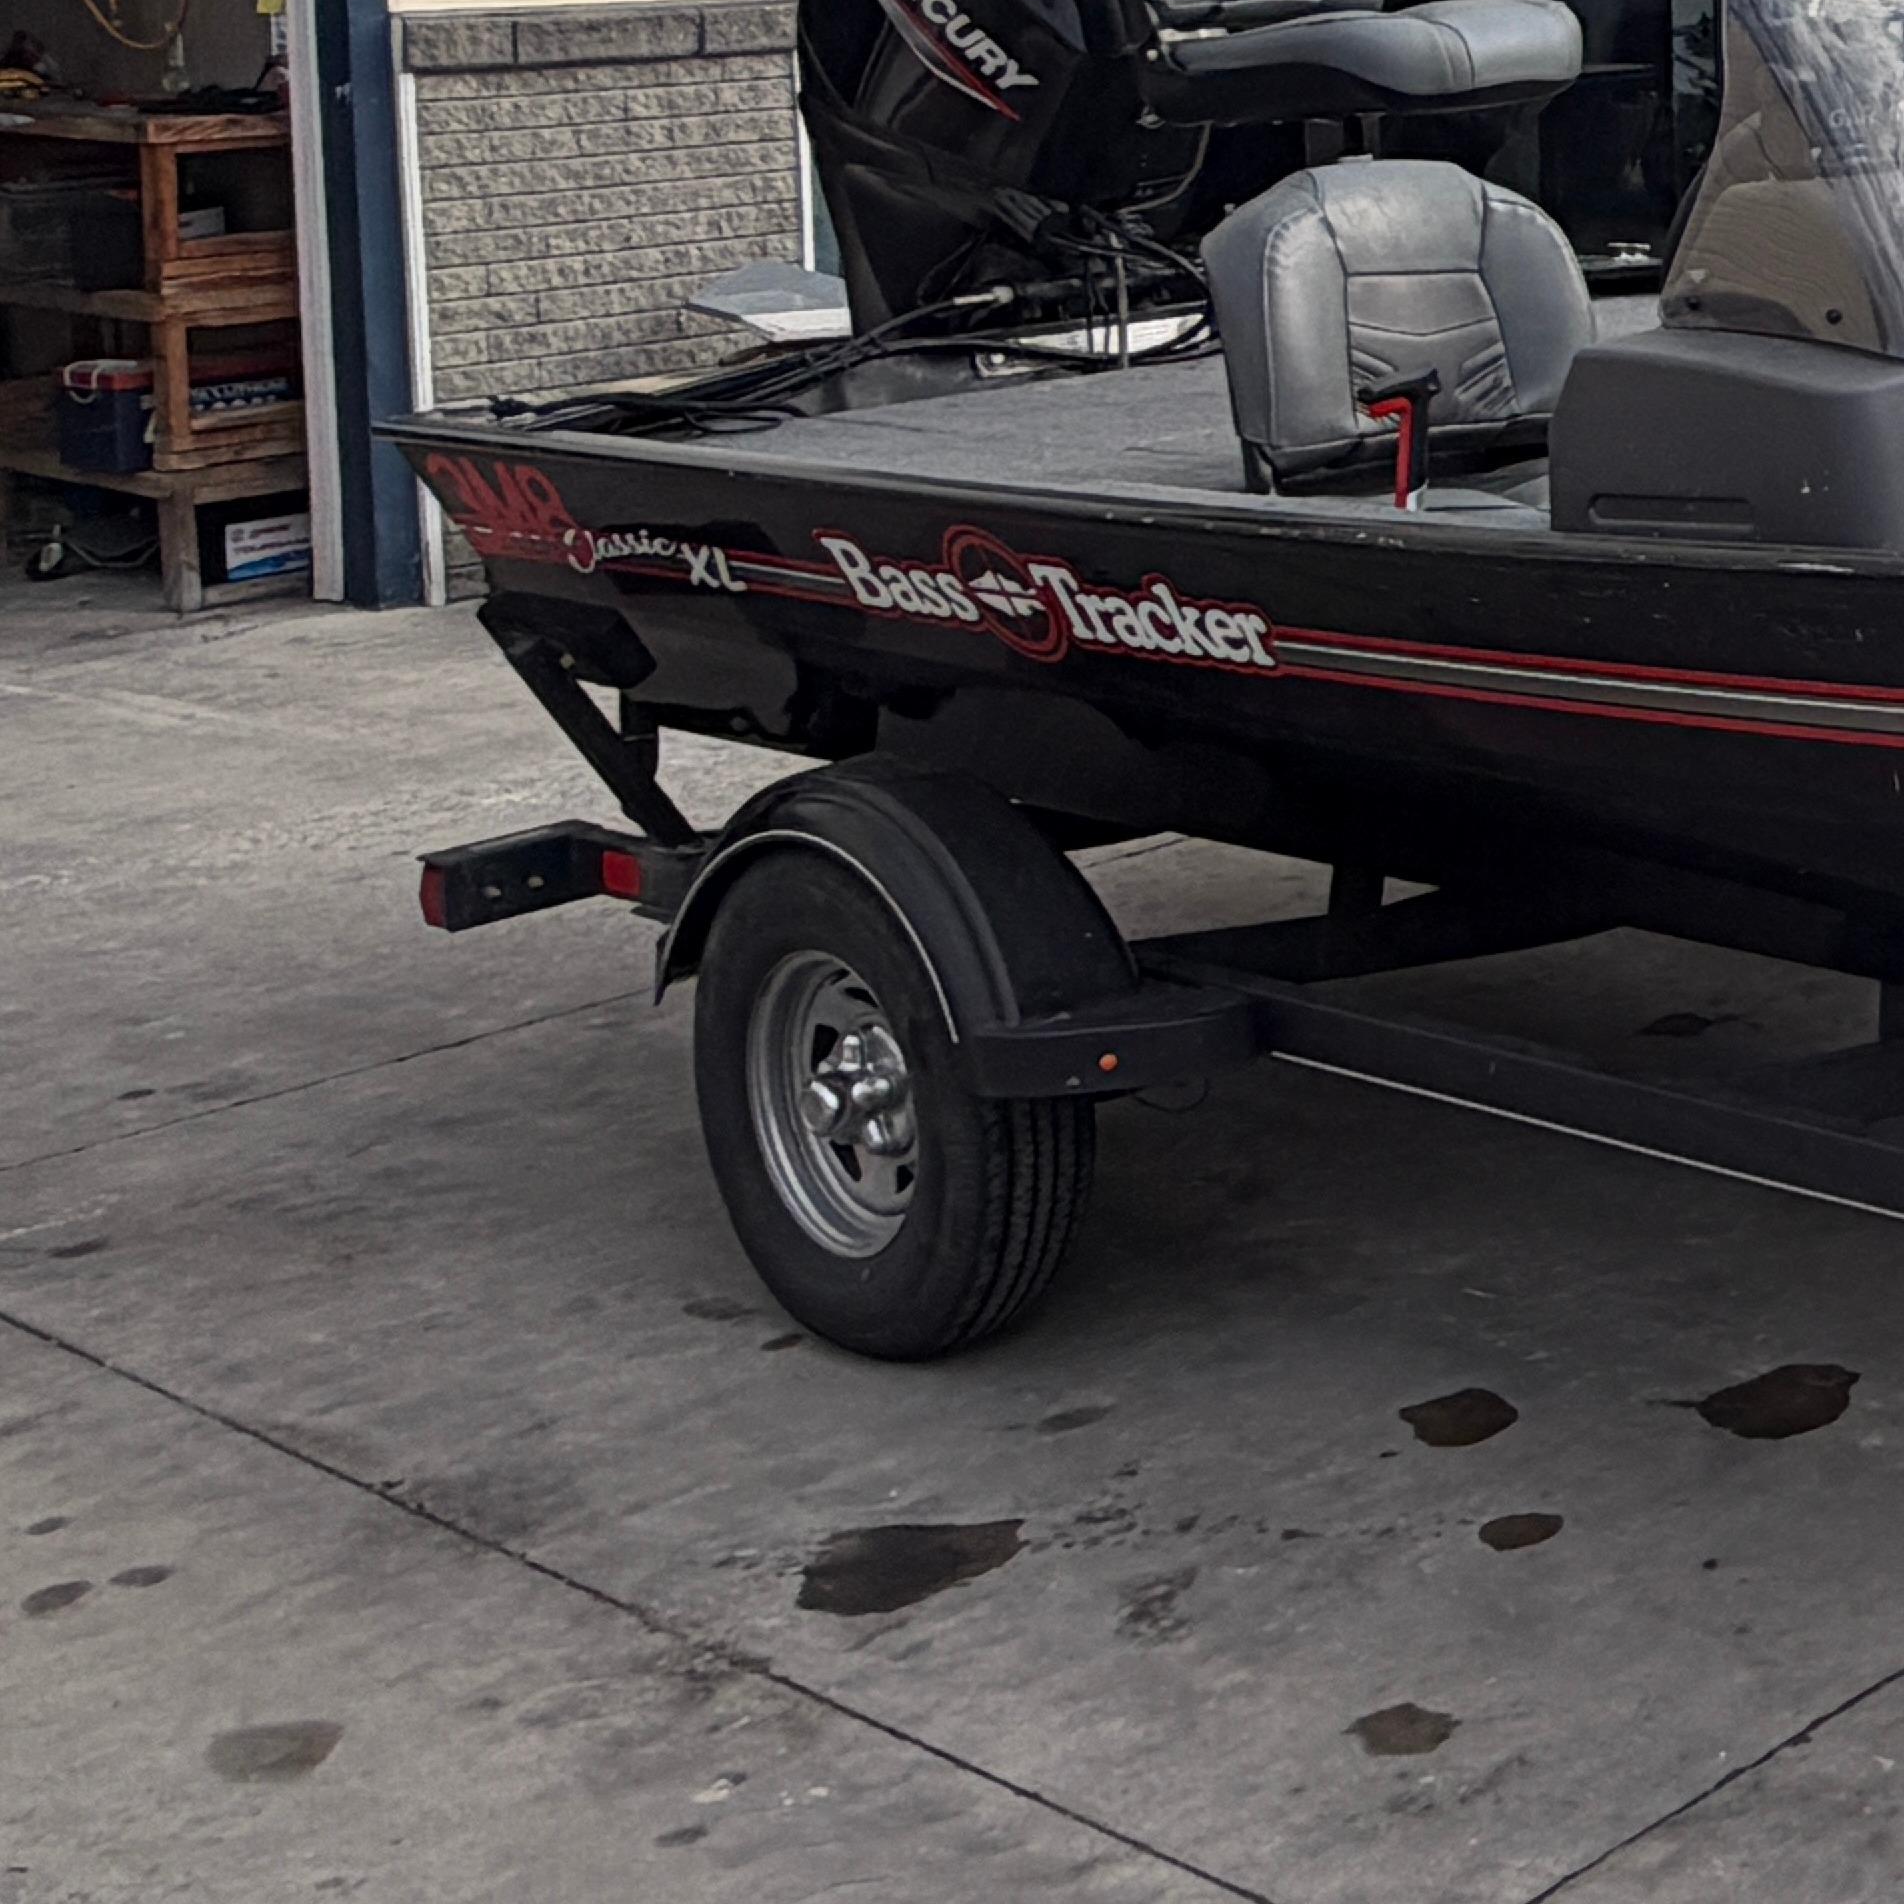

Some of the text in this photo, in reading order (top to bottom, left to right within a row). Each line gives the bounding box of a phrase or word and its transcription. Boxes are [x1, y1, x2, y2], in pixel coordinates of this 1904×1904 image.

[680, 543, 748, 591] XL
[819, 537, 1277, 667] Bass Tracker
